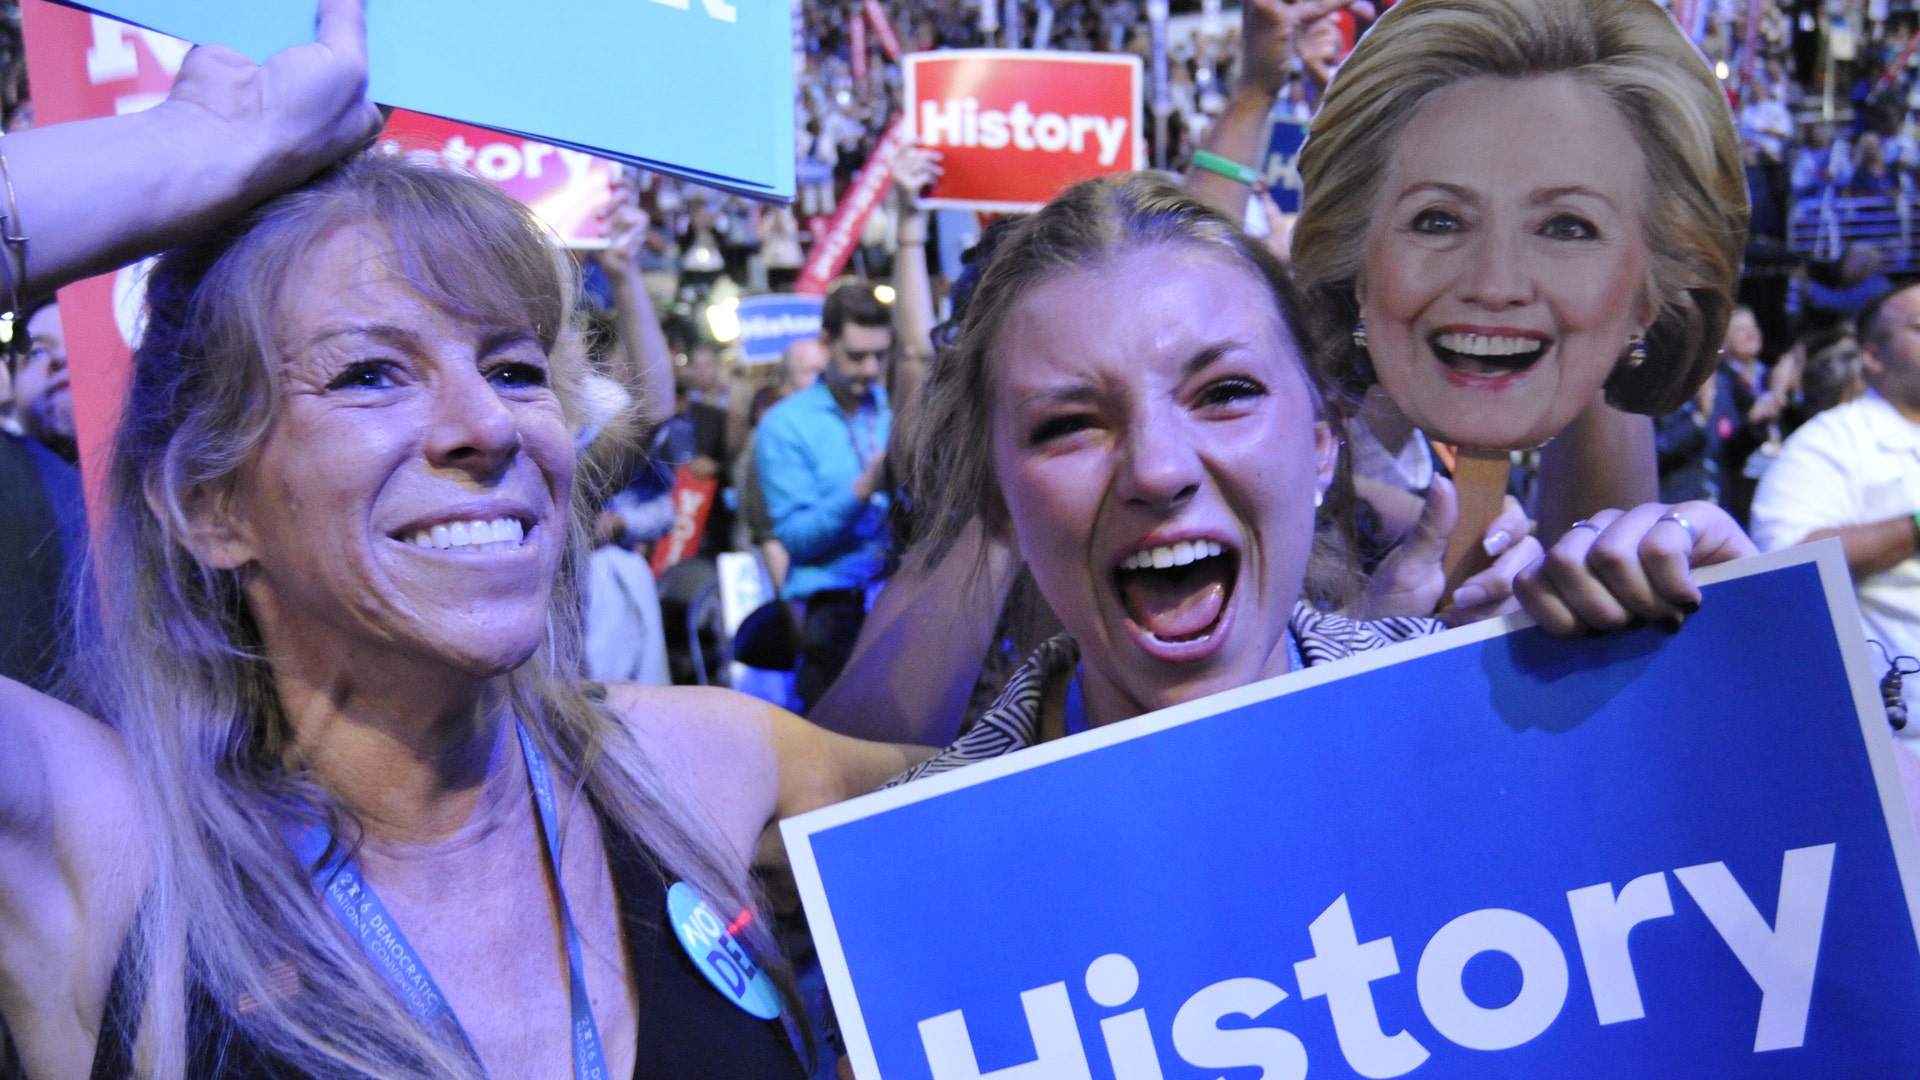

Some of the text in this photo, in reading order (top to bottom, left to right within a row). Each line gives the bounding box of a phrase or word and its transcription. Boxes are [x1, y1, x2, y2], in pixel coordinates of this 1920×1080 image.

[921, 97, 1127, 166] History
[329, 883, 370, 939] NATIONAL
[369, 914, 439, 1007] DEMOCRATIC
